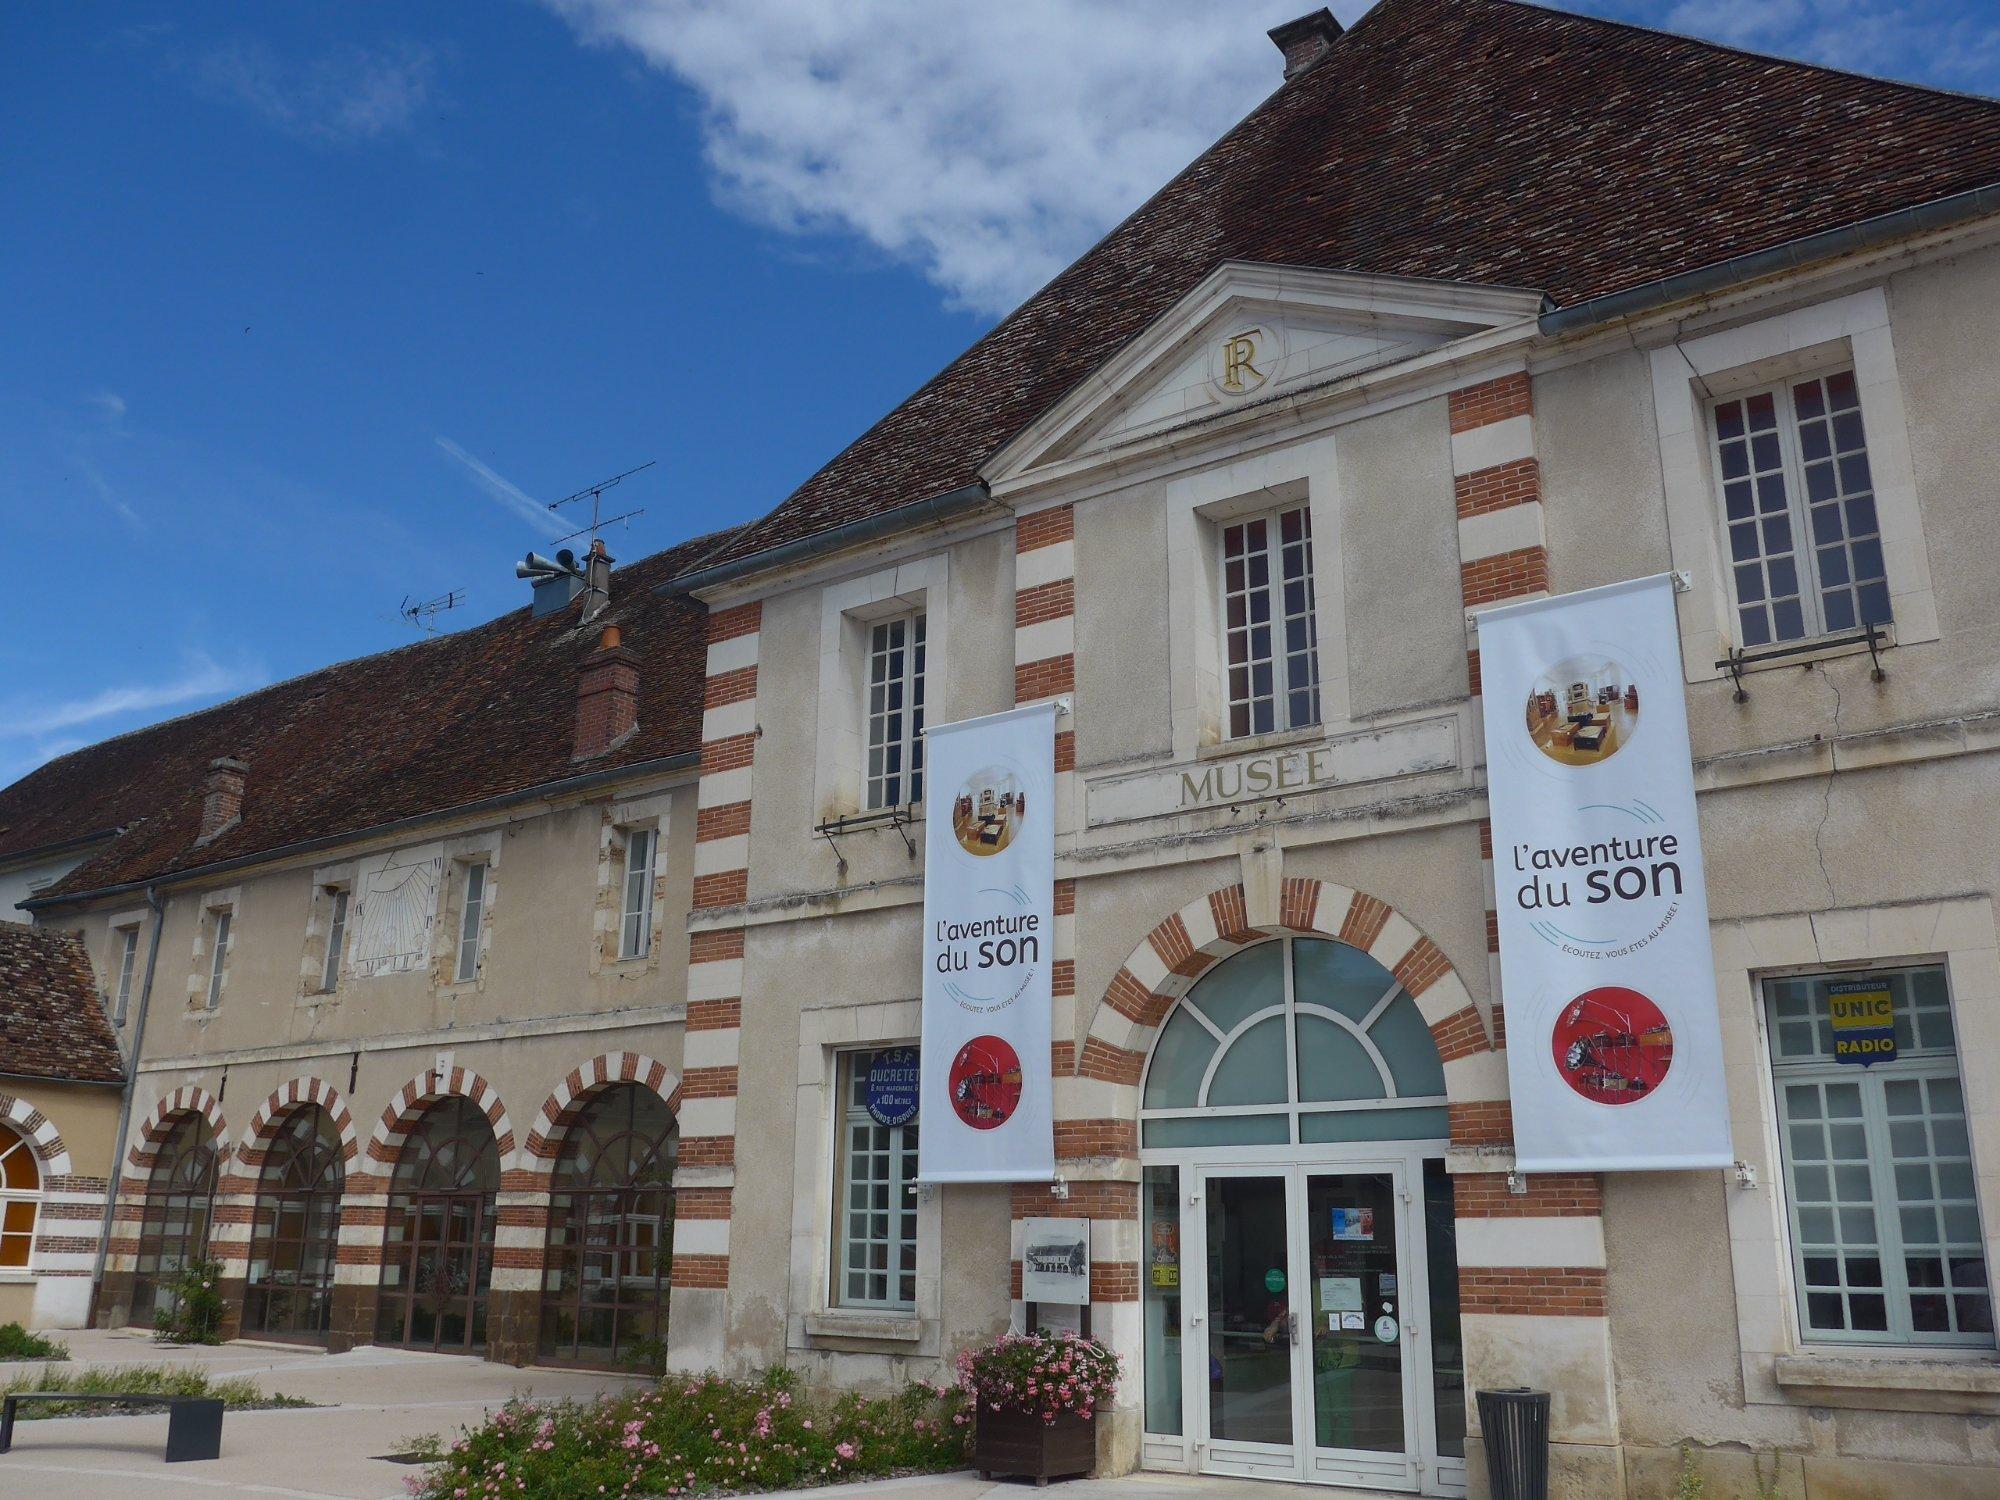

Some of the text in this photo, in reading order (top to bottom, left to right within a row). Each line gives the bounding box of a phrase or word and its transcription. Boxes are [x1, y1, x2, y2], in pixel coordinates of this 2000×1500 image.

[1514, 835, 1678, 871] l'aventure
[1517, 862, 1683, 910] du son
[937, 914, 1039, 941] l'aventure
[936, 936, 1038, 973] du son
[1606, 946, 1629, 959] VOUS
[1648, 929, 1659, 944] AU
[1830, 982, 1888, 993] DISTRIBUTEUR
[1833, 1000, 1890, 1018] UNIC
[1837, 1038, 1895, 1054] RADIO
[871, 1069, 920, 1081] DUCRETET
[881, 1094, 894, 1105] 100
